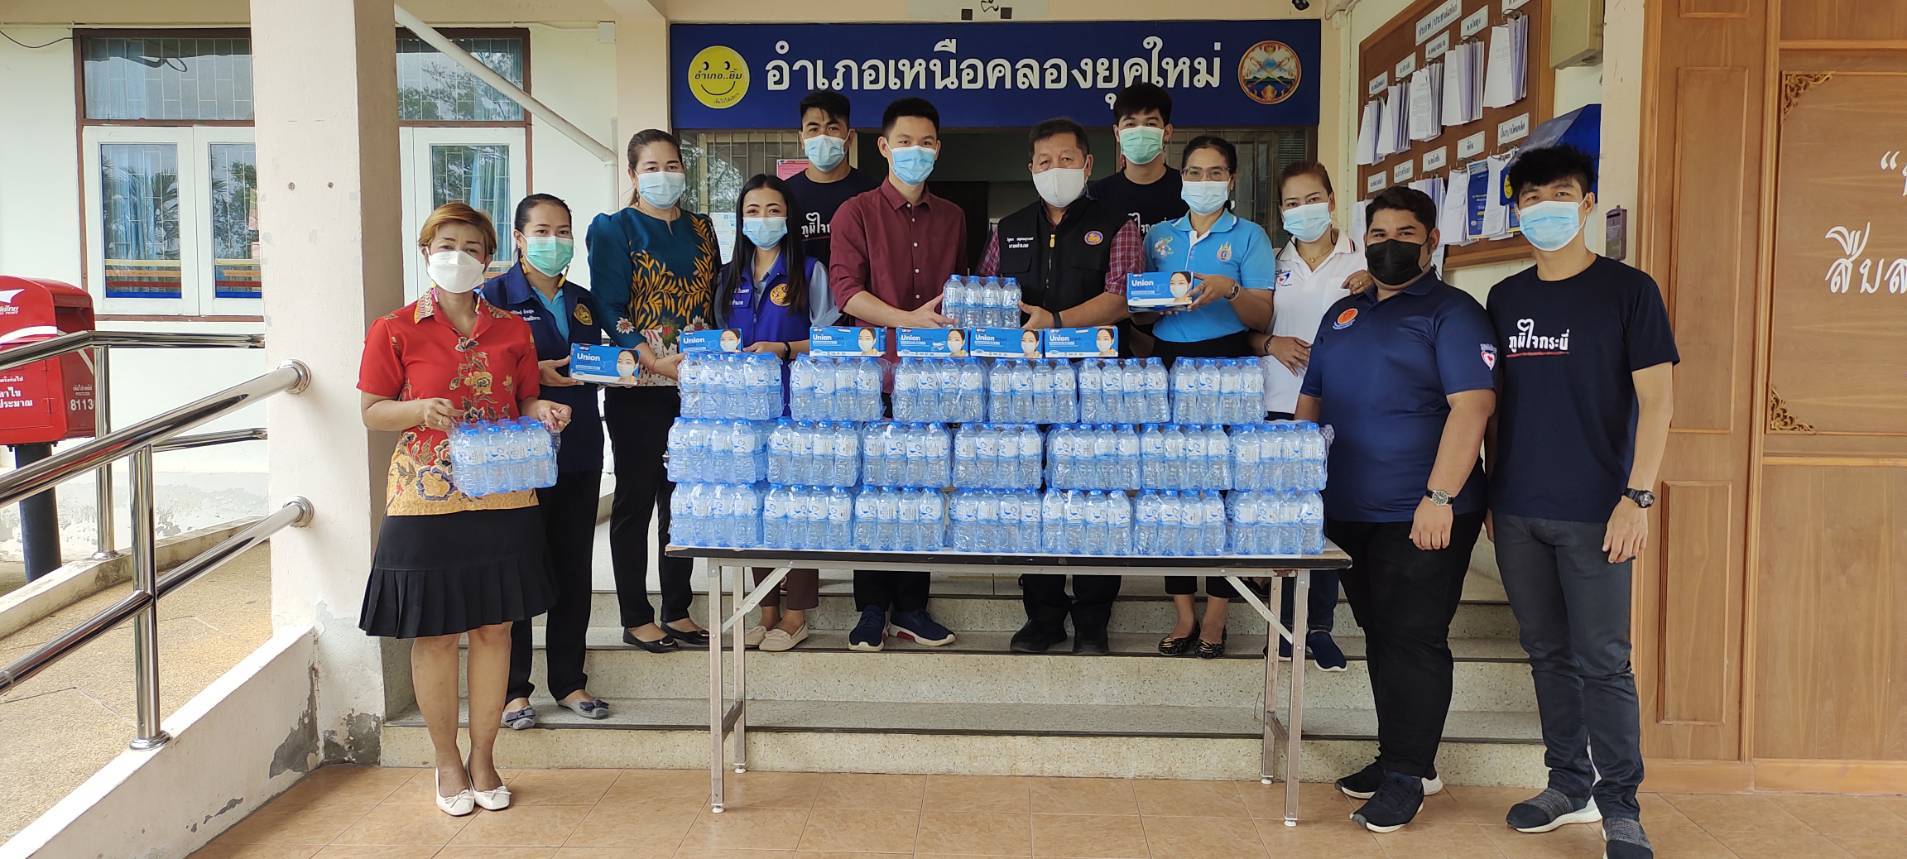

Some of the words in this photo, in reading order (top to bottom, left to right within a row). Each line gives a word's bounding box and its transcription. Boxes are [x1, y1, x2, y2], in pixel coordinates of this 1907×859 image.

[765, 35, 1221, 110] อำเภอเหนือคลองยุคใหม่
[1131, 279, 1154, 288] Union
[683, 336, 705, 344] Union
[975, 334, 995, 342] Union
[1049, 334, 1070, 342] Union
[1508, 318, 1570, 353] ภูมิใจกระบี่
[576, 352, 601, 362] Union
